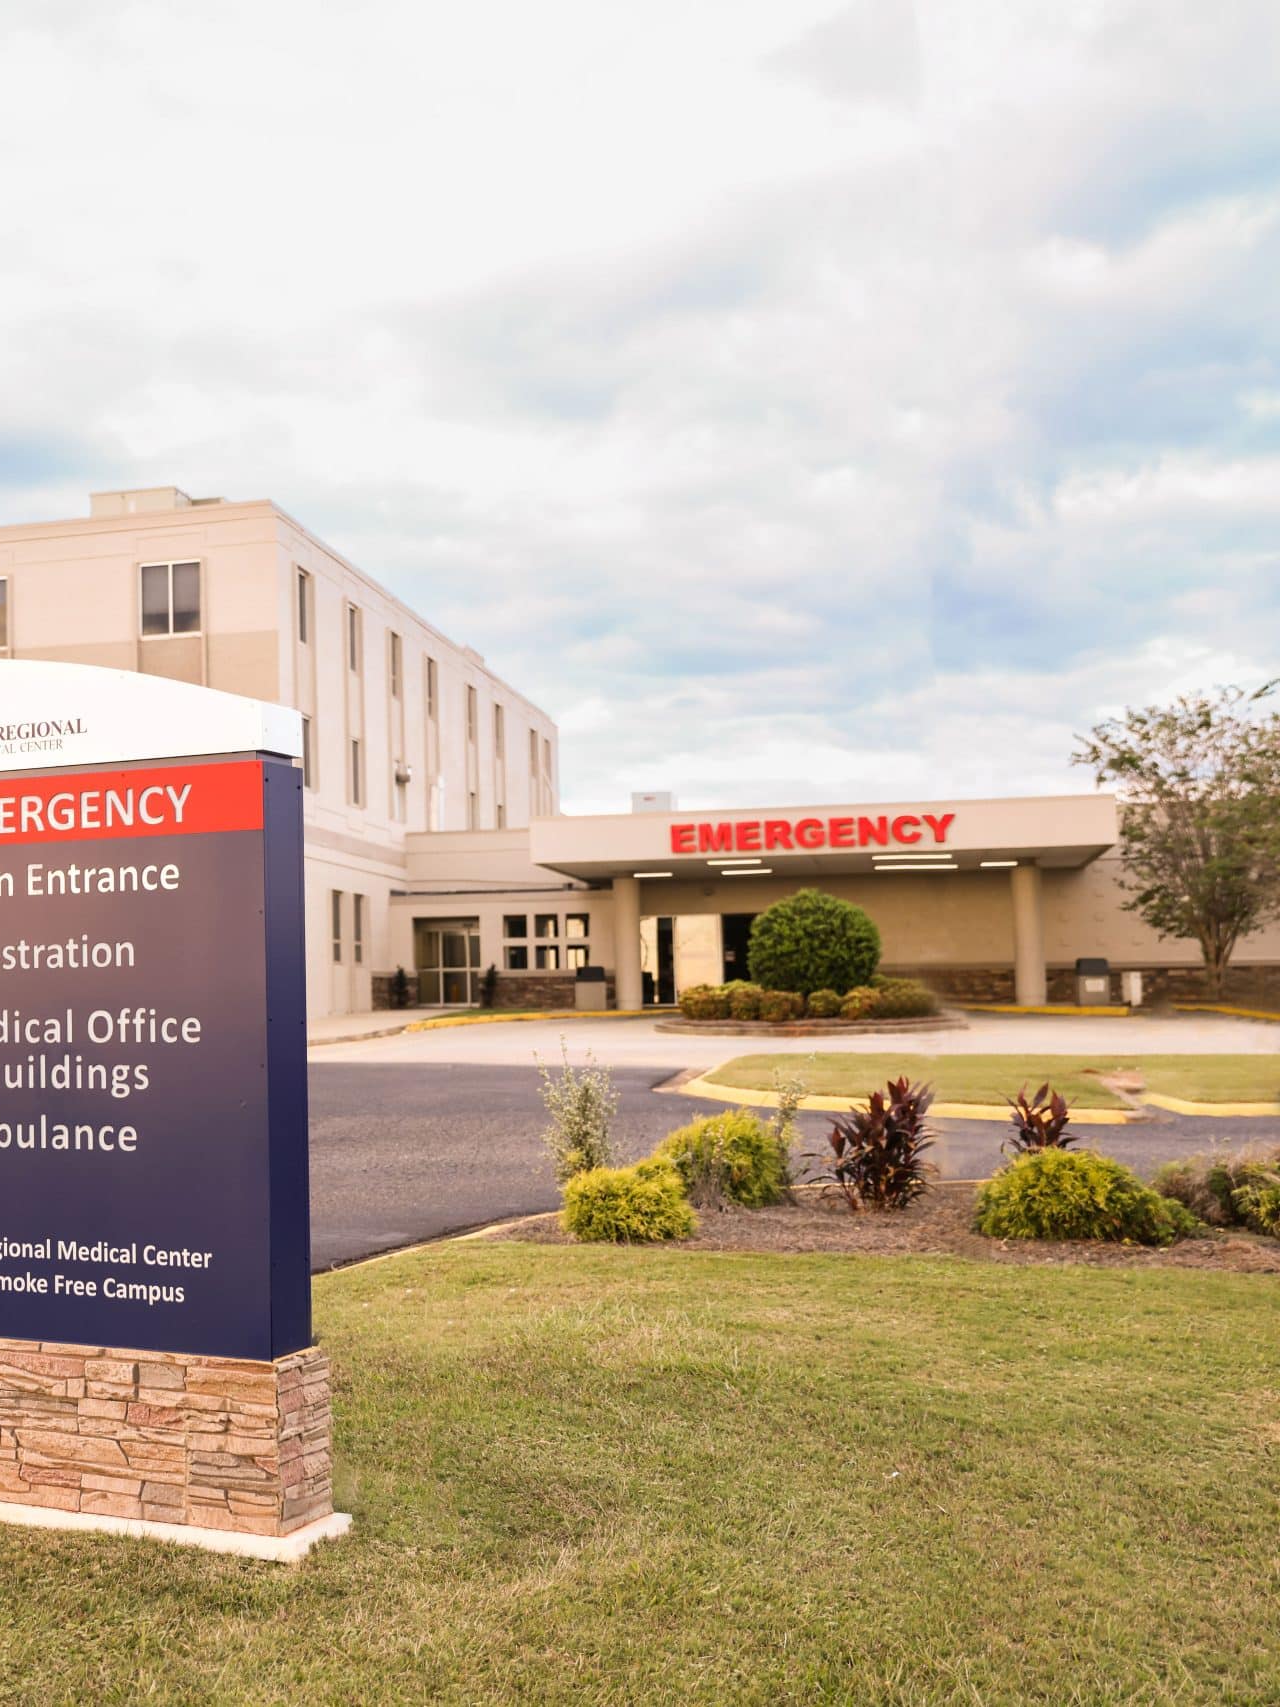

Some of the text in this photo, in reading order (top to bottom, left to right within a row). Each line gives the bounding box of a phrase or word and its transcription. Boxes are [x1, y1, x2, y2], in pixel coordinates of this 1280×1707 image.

[20, 738, 63, 753] CENTER
[670, 813, 956, 854] EMERGENCY
[27, 862, 180, 896] Entrance
[87, 1007, 201, 1043] Office
[57, 1239, 137, 1264] Medical
[143, 1245, 213, 1269] Center
[54, 1274, 97, 1297] Free
[103, 1277, 185, 1306] Campus
